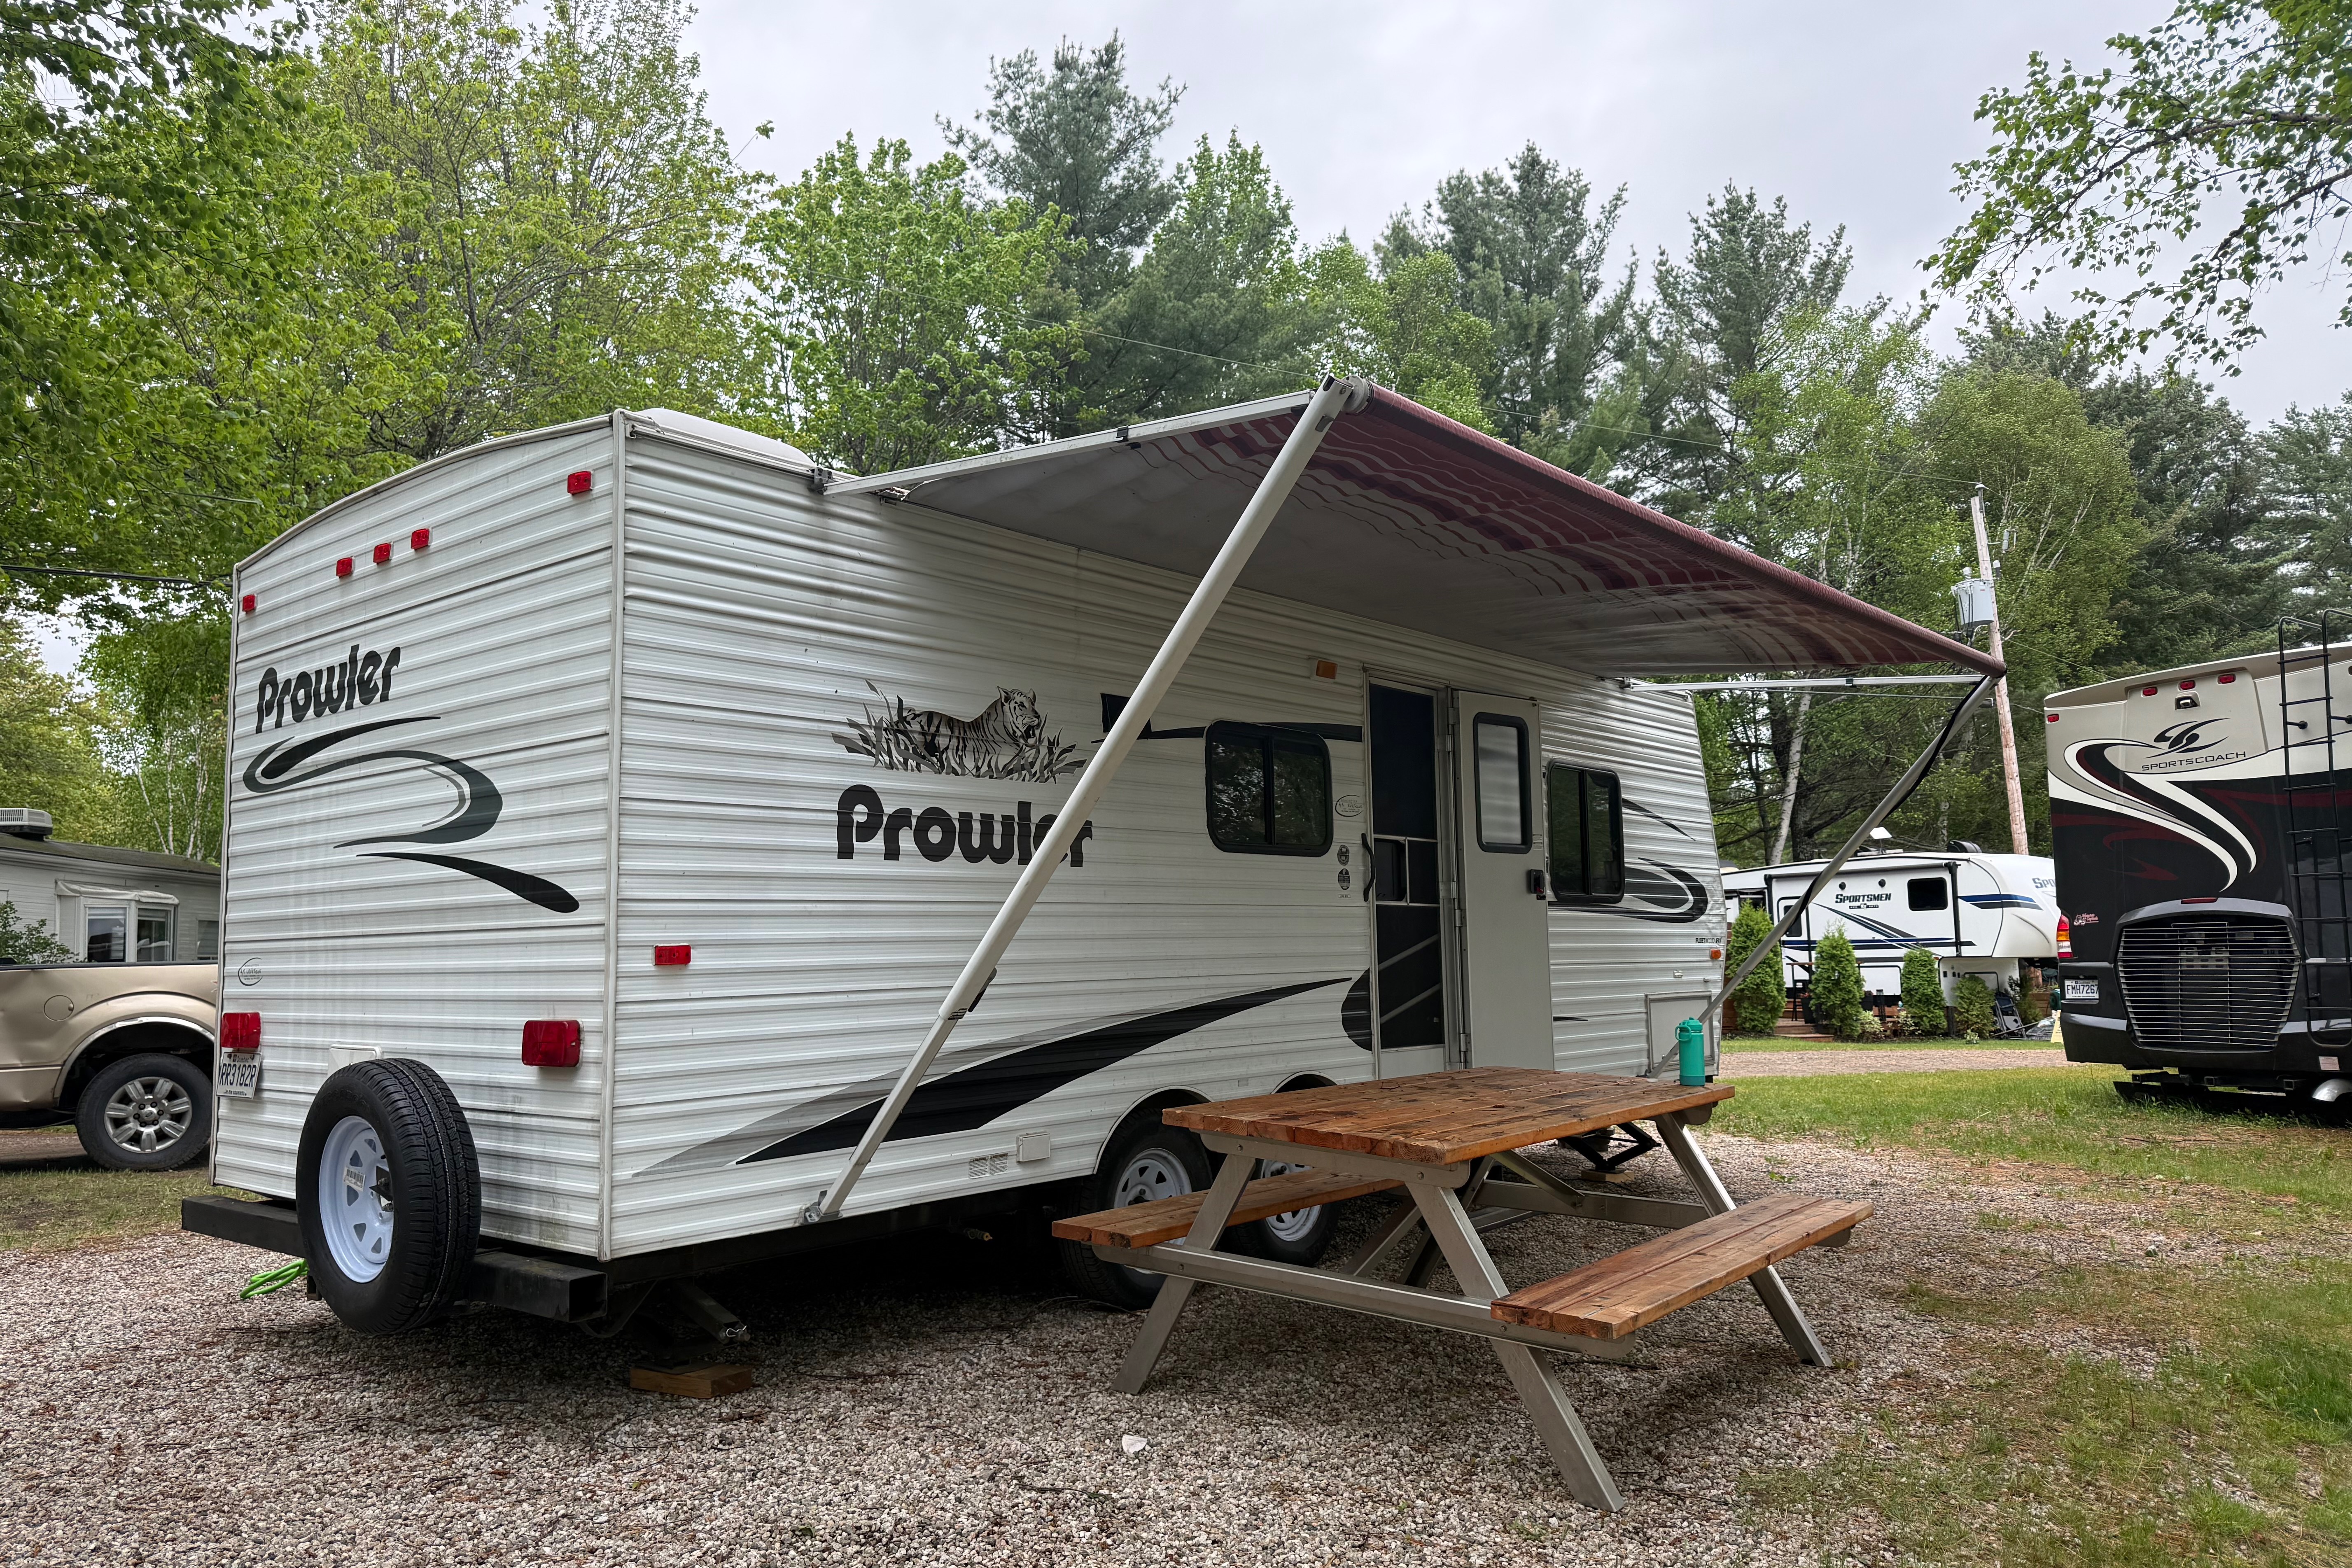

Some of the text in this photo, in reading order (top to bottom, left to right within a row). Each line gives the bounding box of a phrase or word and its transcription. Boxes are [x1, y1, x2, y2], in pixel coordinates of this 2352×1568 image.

[256, 644, 401, 734] Prowler
[2142, 751, 2246, 771] SPORTSCOACH
[1835, 893, 1892, 903] SPORTSMEN
[2067, 984, 2099, 994] FMH7267
[219, 1063, 257, 1087] RR3182R
